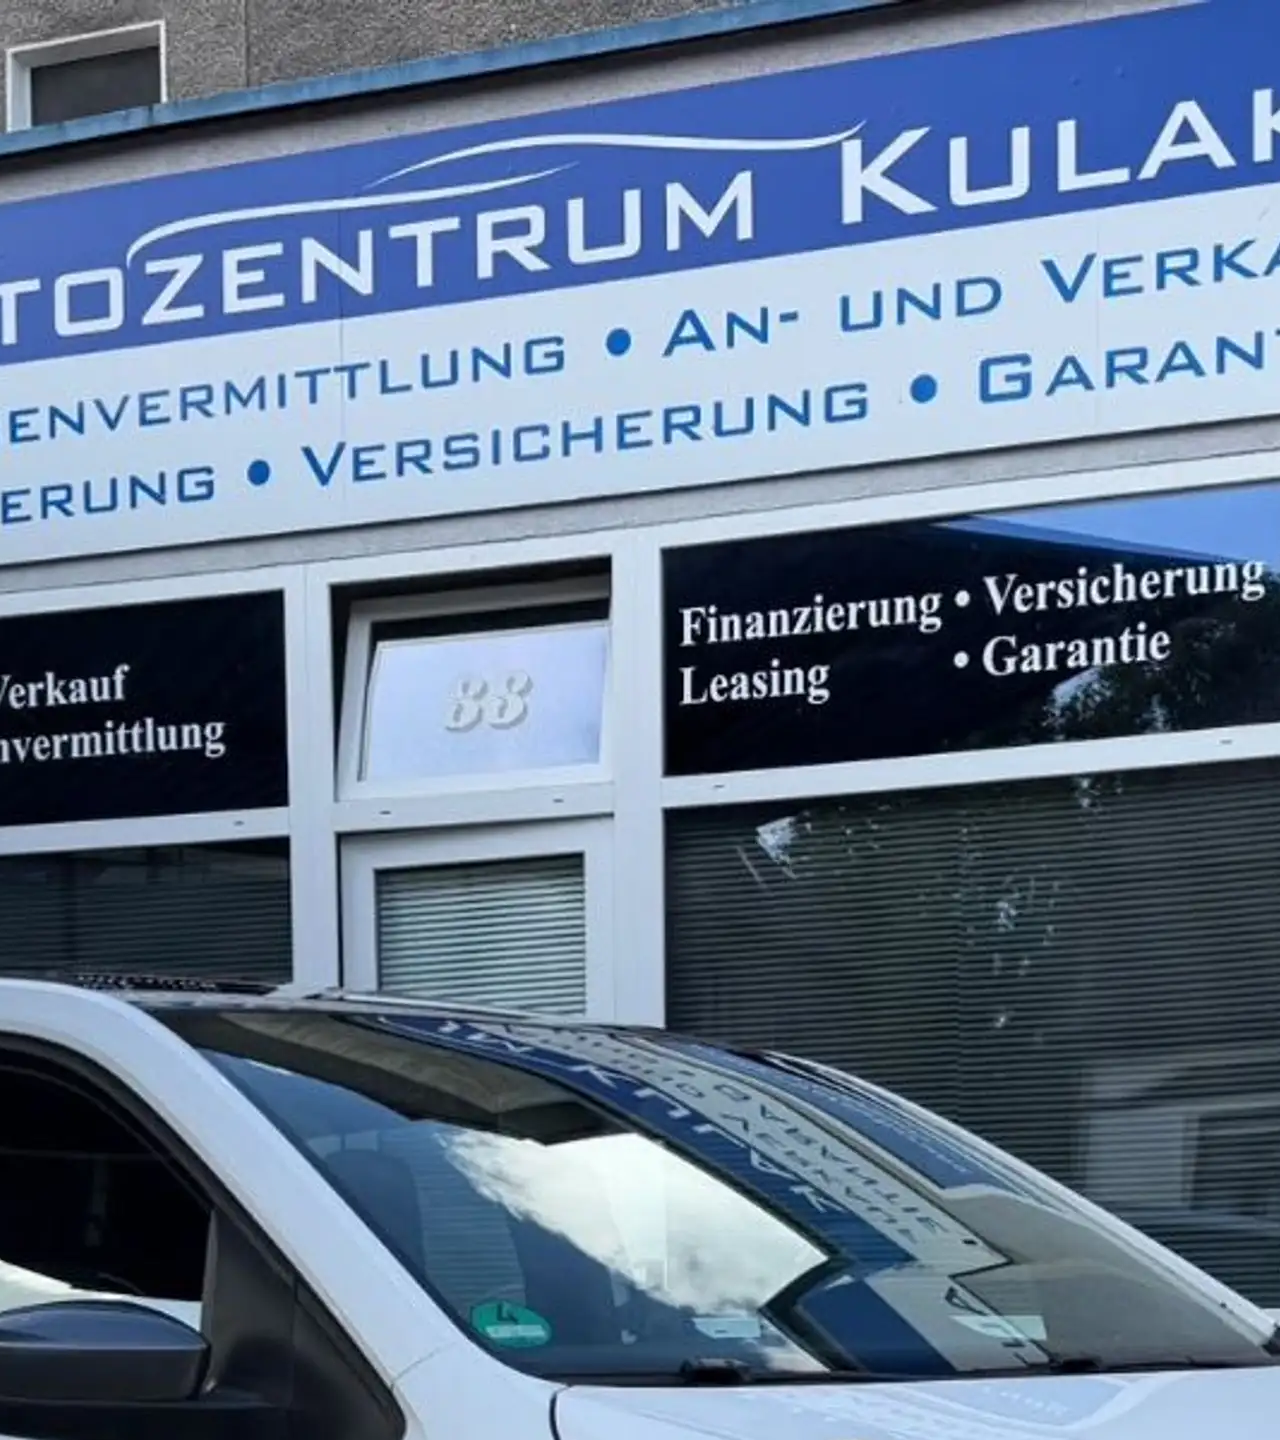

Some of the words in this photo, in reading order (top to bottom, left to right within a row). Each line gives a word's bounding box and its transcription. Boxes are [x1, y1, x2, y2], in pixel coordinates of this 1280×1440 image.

[663, 307, 799, 357] AN-
[840, 276, 1002, 333] UND
[302, 383, 868, 487] VERSICHERUNG
[681, 592, 942, 647] Finanzierung
[984, 557, 1266, 615] Versicherung
[443, 666, 534, 734] 88
[681, 659, 830, 705] Leasing
[983, 622, 1171, 676] Garantie
